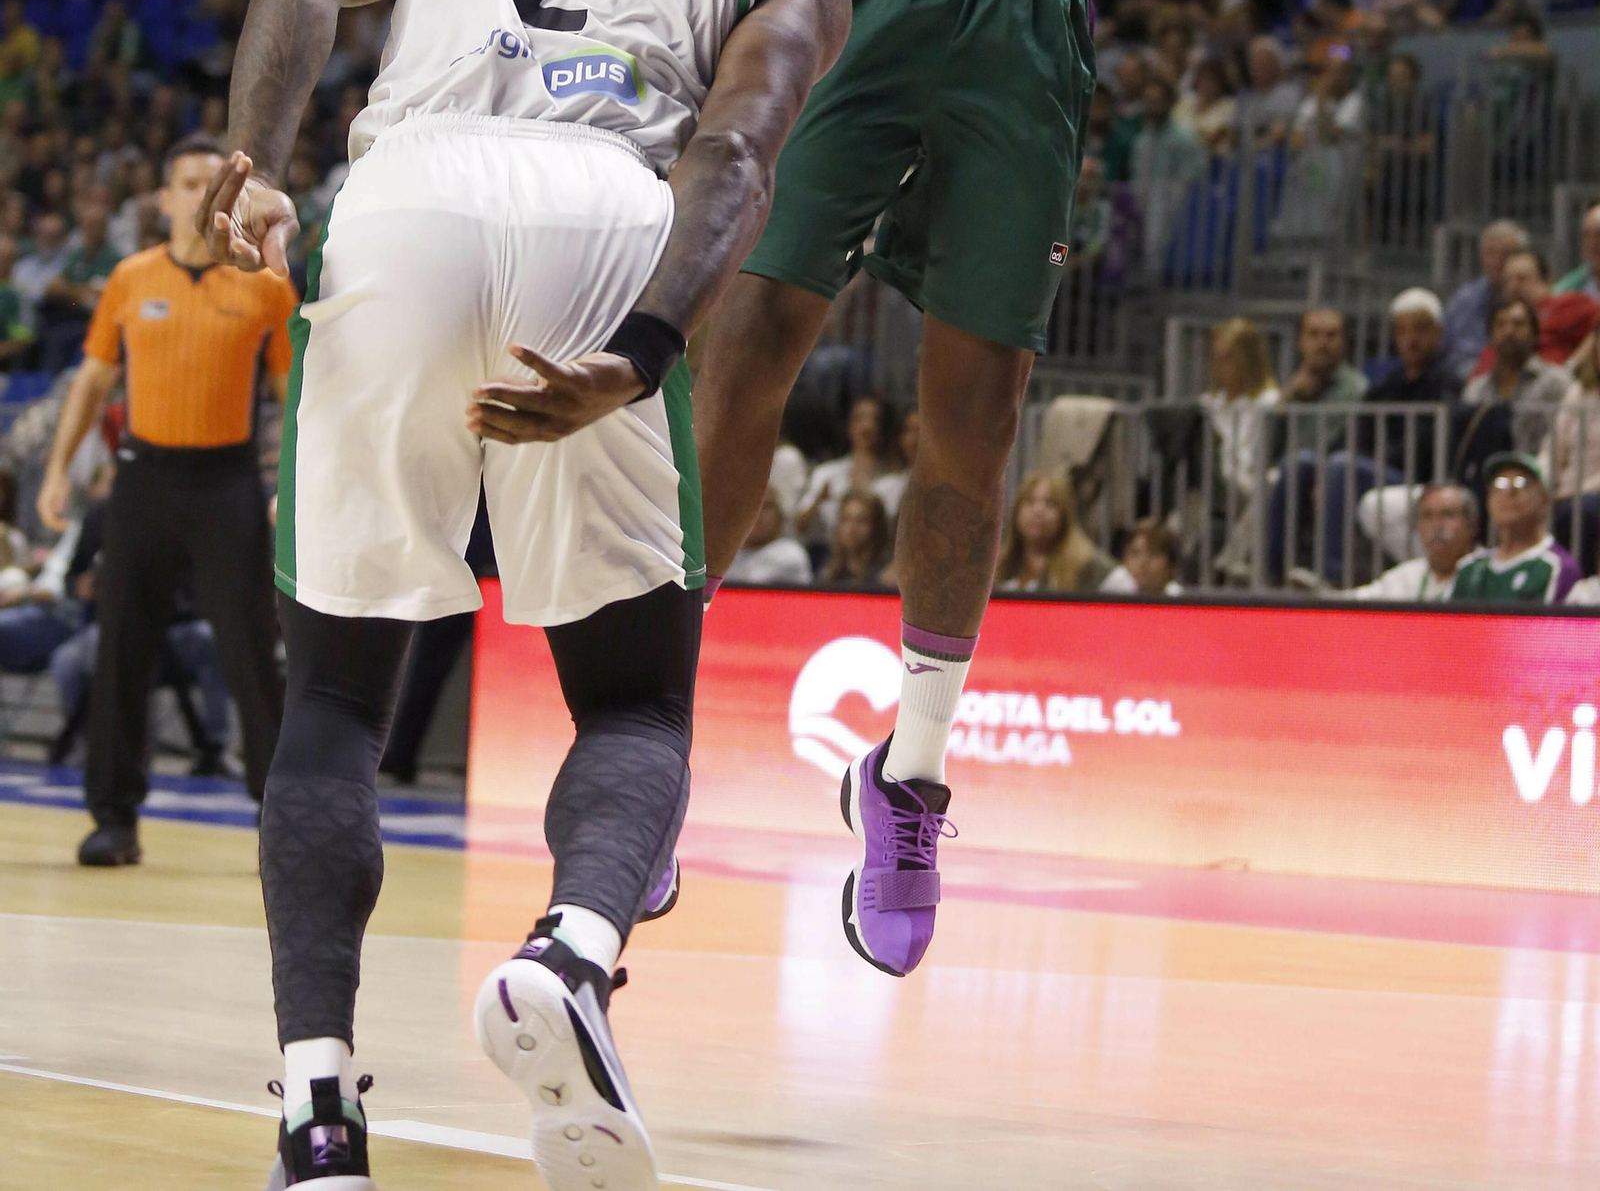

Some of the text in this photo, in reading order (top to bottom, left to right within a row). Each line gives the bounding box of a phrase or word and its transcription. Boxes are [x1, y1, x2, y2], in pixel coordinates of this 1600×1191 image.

[551, 61, 627, 92] plus
[952, 690, 1182, 738] OSTA DEL SOL
